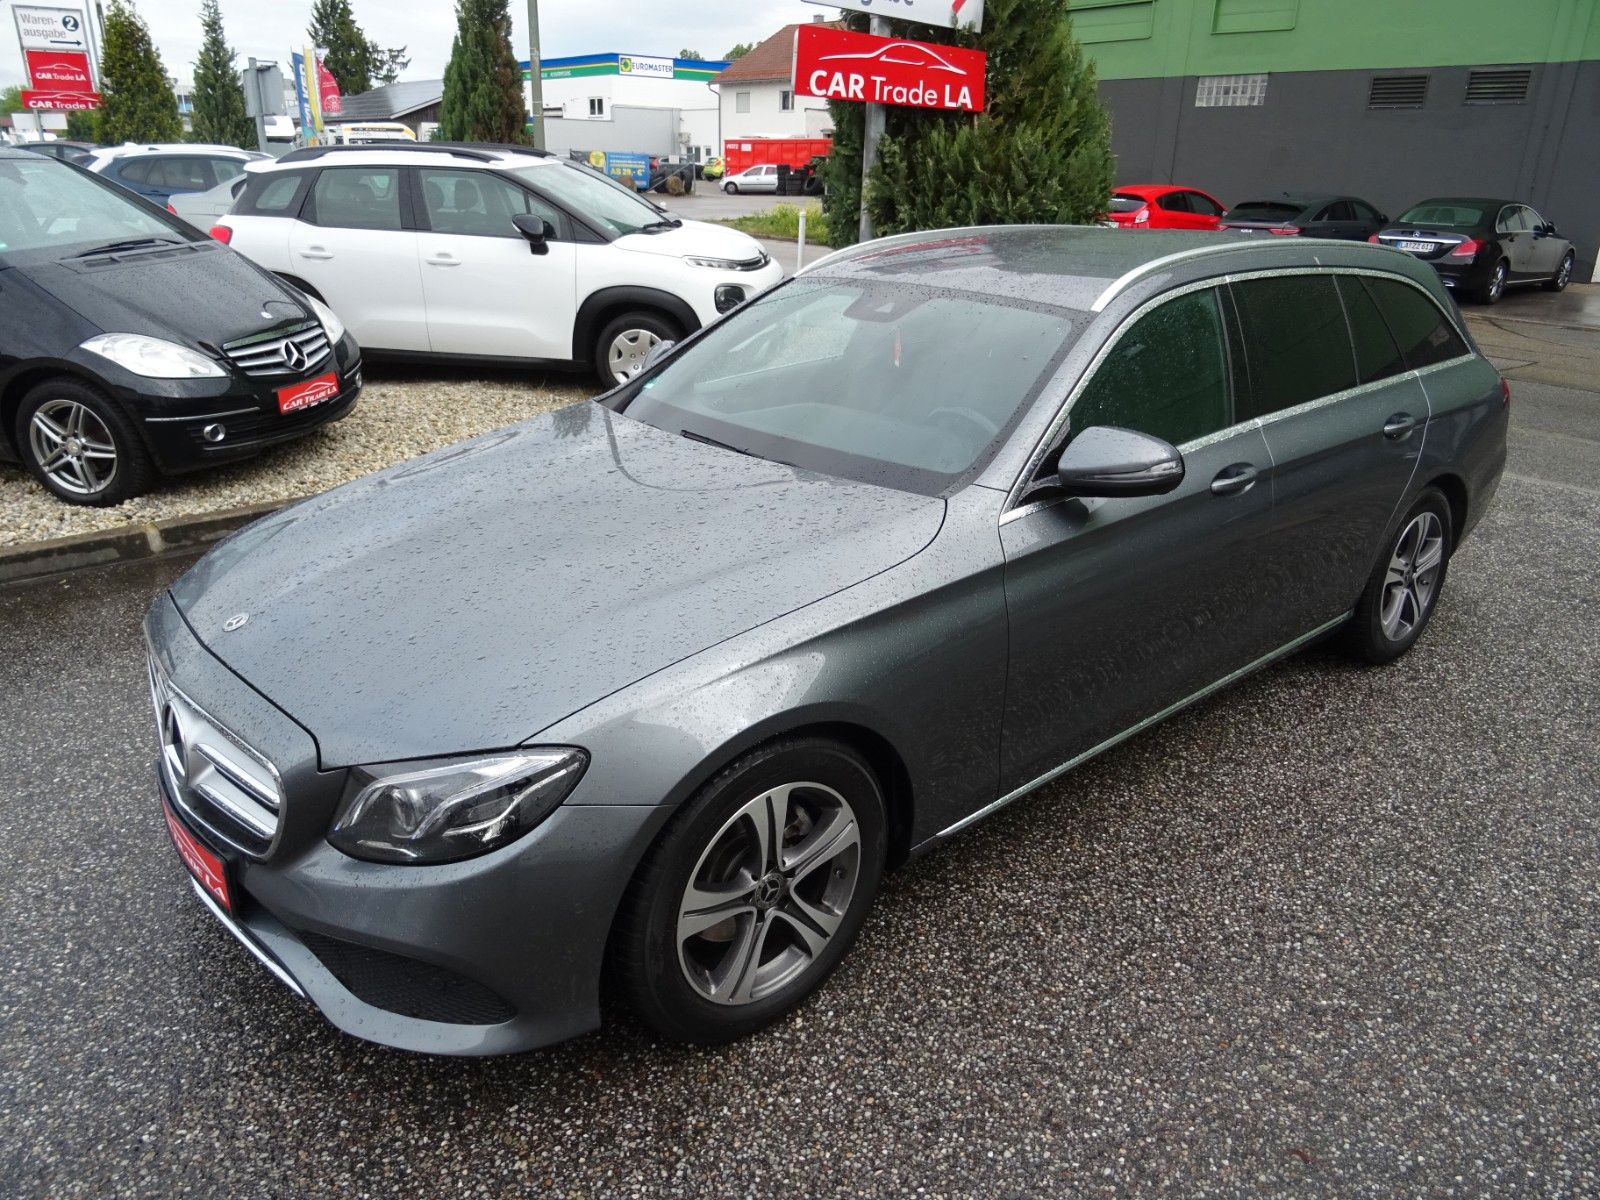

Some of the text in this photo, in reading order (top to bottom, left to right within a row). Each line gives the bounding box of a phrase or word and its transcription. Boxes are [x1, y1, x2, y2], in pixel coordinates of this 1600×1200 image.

[20, 13, 58, 25] Waren-
[65, 16, 75, 30] 2
[23, 28, 67, 39] ausgabe
[632, 62, 673, 73] EUROMASTER
[36, 72, 53, 80] CAR
[53, 73, 75, 81] Trade
[809, 70, 973, 109] CAR Trade LA
[29, 100, 54, 109] CAR
[54, 101, 87, 110] Trade
[283, 398, 303, 410] CAR
[327, 385, 338, 395] LA
[205, 872, 227, 902] LA
